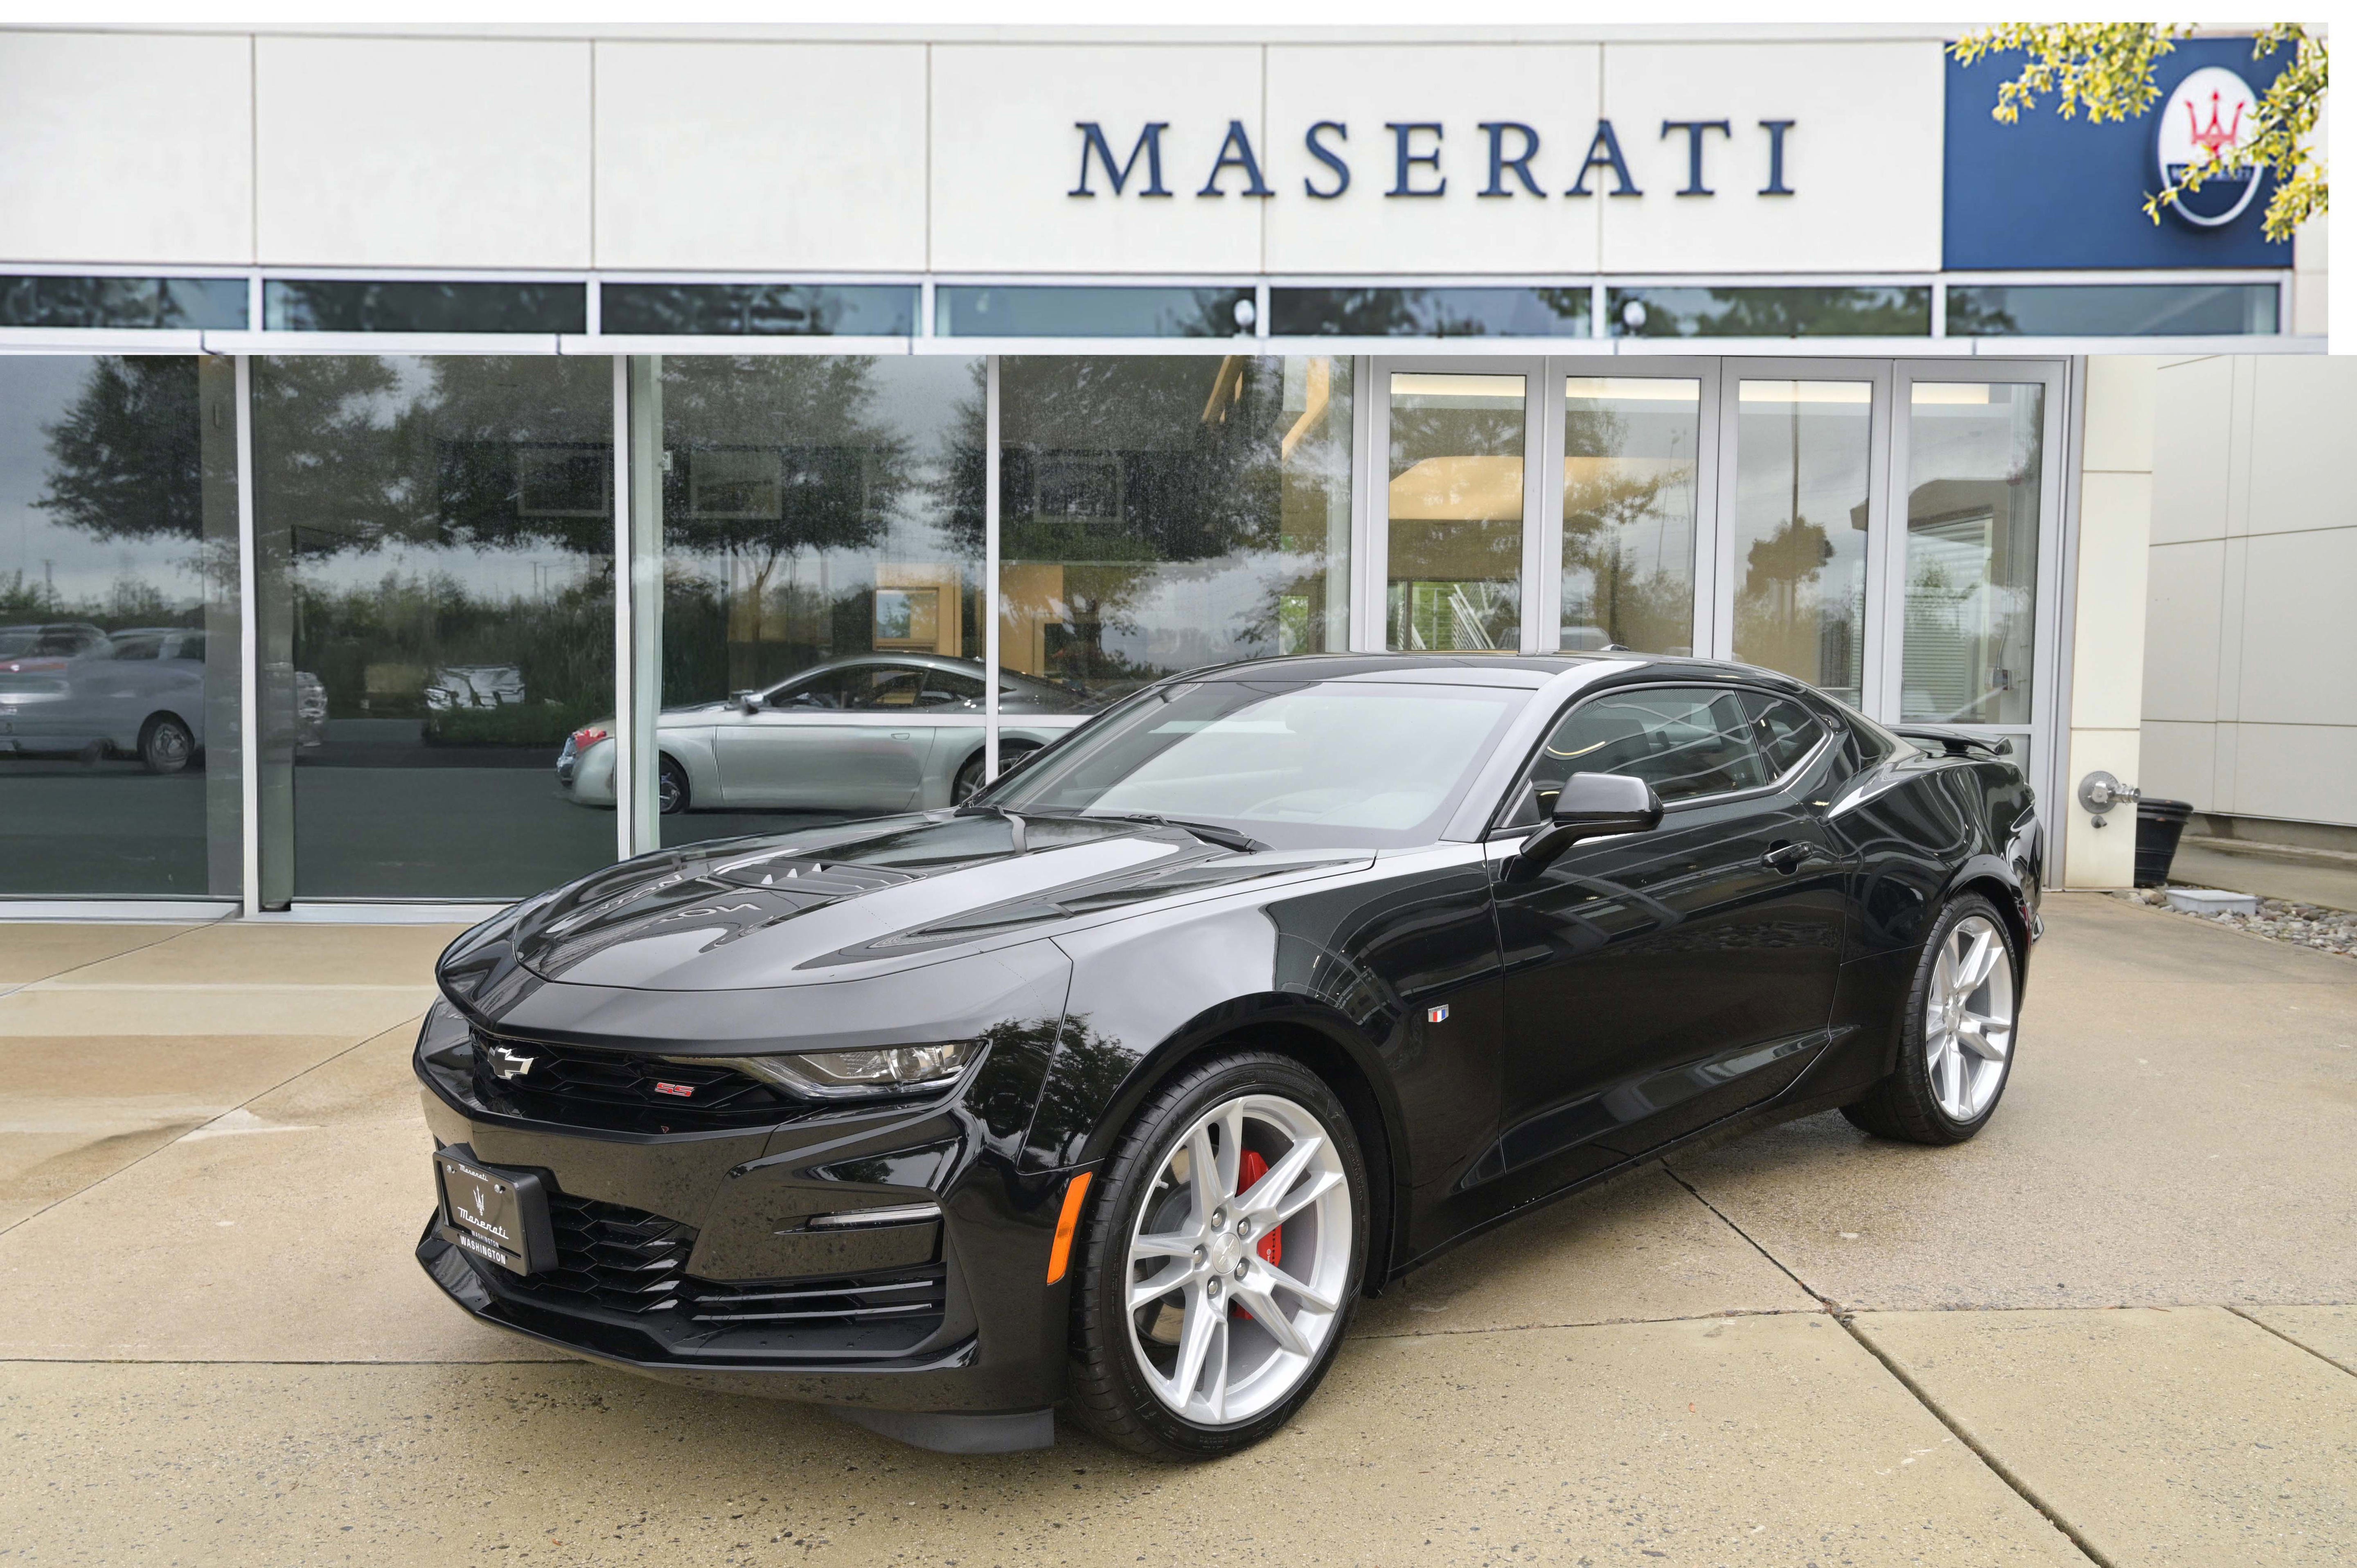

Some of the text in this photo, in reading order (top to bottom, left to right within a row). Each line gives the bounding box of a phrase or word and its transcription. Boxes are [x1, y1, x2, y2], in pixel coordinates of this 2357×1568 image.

[1067, 118, 1796, 198] MASERATI
[655, 1082, 695, 1097] SS
[458, 1164, 489, 1182] Maserati
[457, 1206, 509, 1239] Maserati
[460, 1235, 506, 1265] WASHINGTON
[471, 1230, 499, 1248] WASHINGTON
